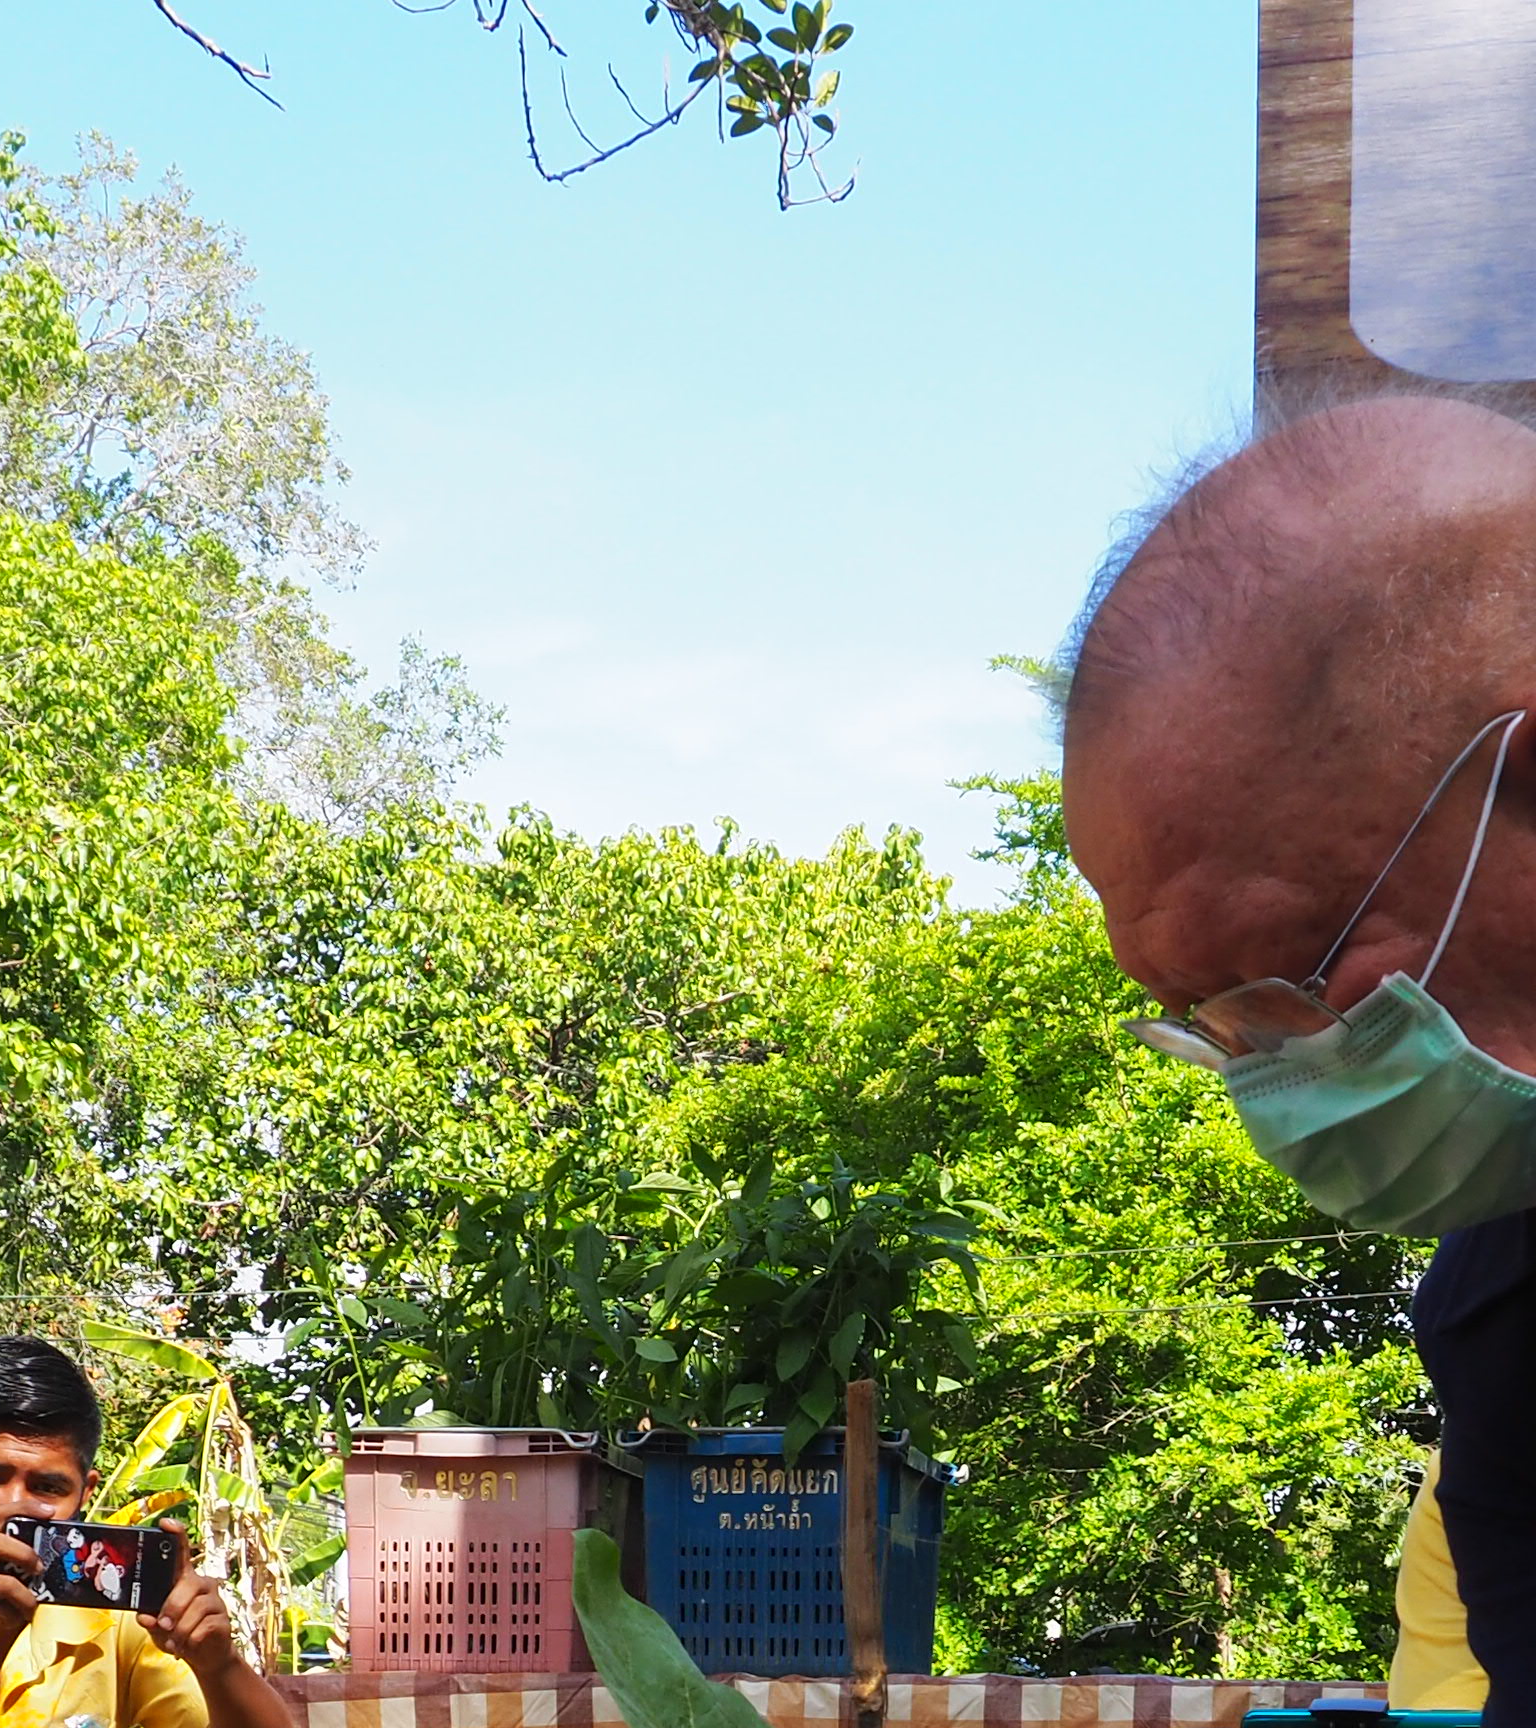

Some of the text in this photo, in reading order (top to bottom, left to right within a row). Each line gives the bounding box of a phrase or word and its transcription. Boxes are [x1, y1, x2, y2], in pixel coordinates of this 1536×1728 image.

[689, 1458, 839, 1504] ศูนย์คัดแยก
